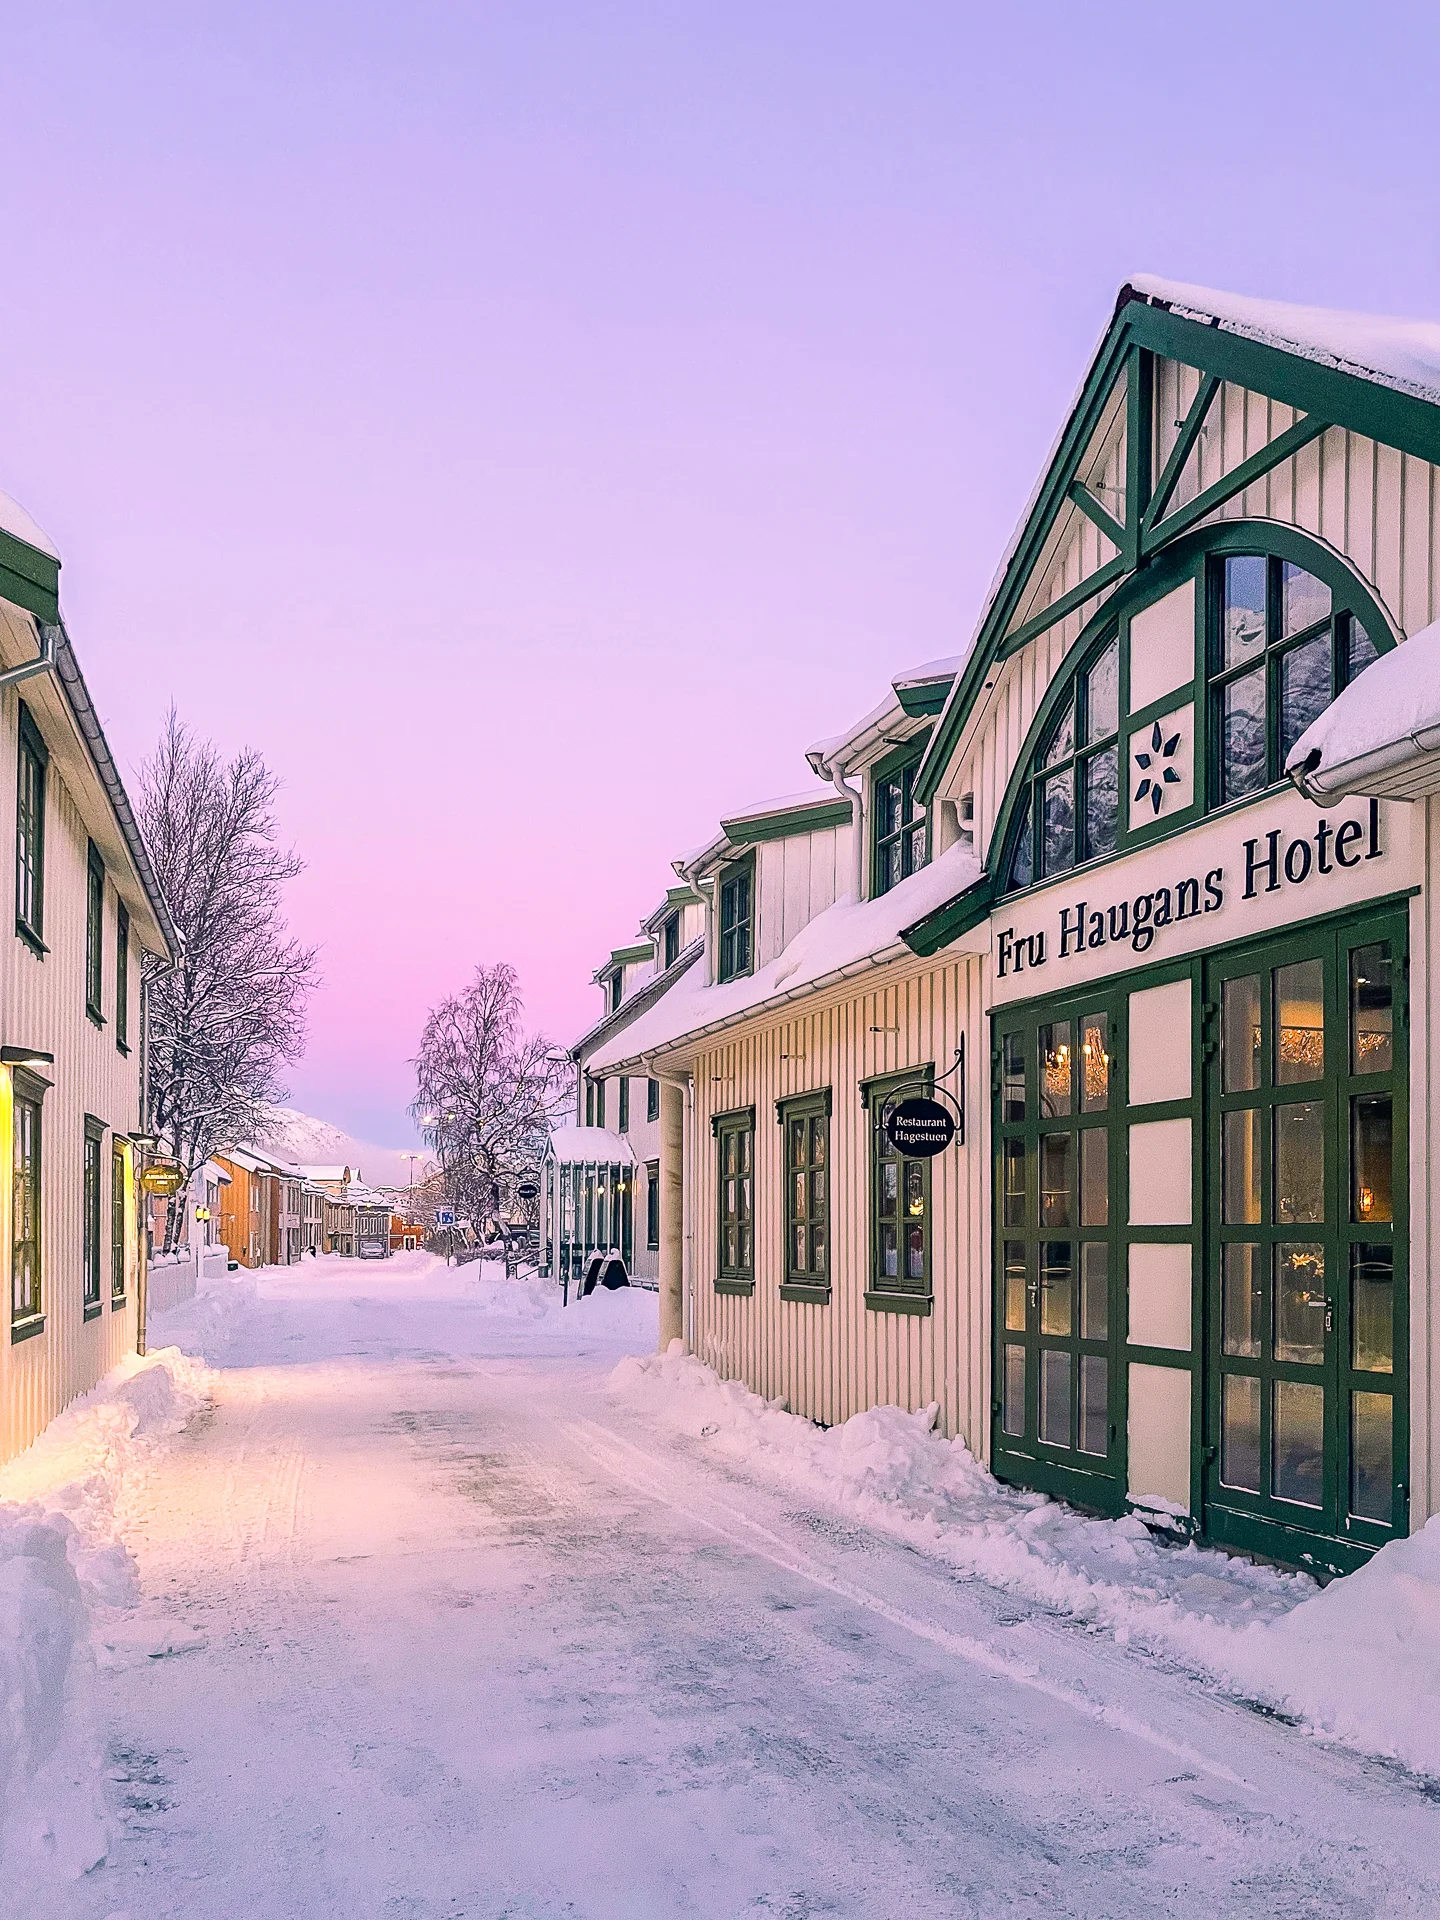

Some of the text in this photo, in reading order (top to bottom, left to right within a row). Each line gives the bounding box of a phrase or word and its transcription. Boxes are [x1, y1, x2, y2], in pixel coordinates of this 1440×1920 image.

[997, 797, 1383, 979] Fru Haugans Hotel
[896, 1116, 947, 1127] Restaurant
[895, 1130, 948, 1144] Hagestuen
